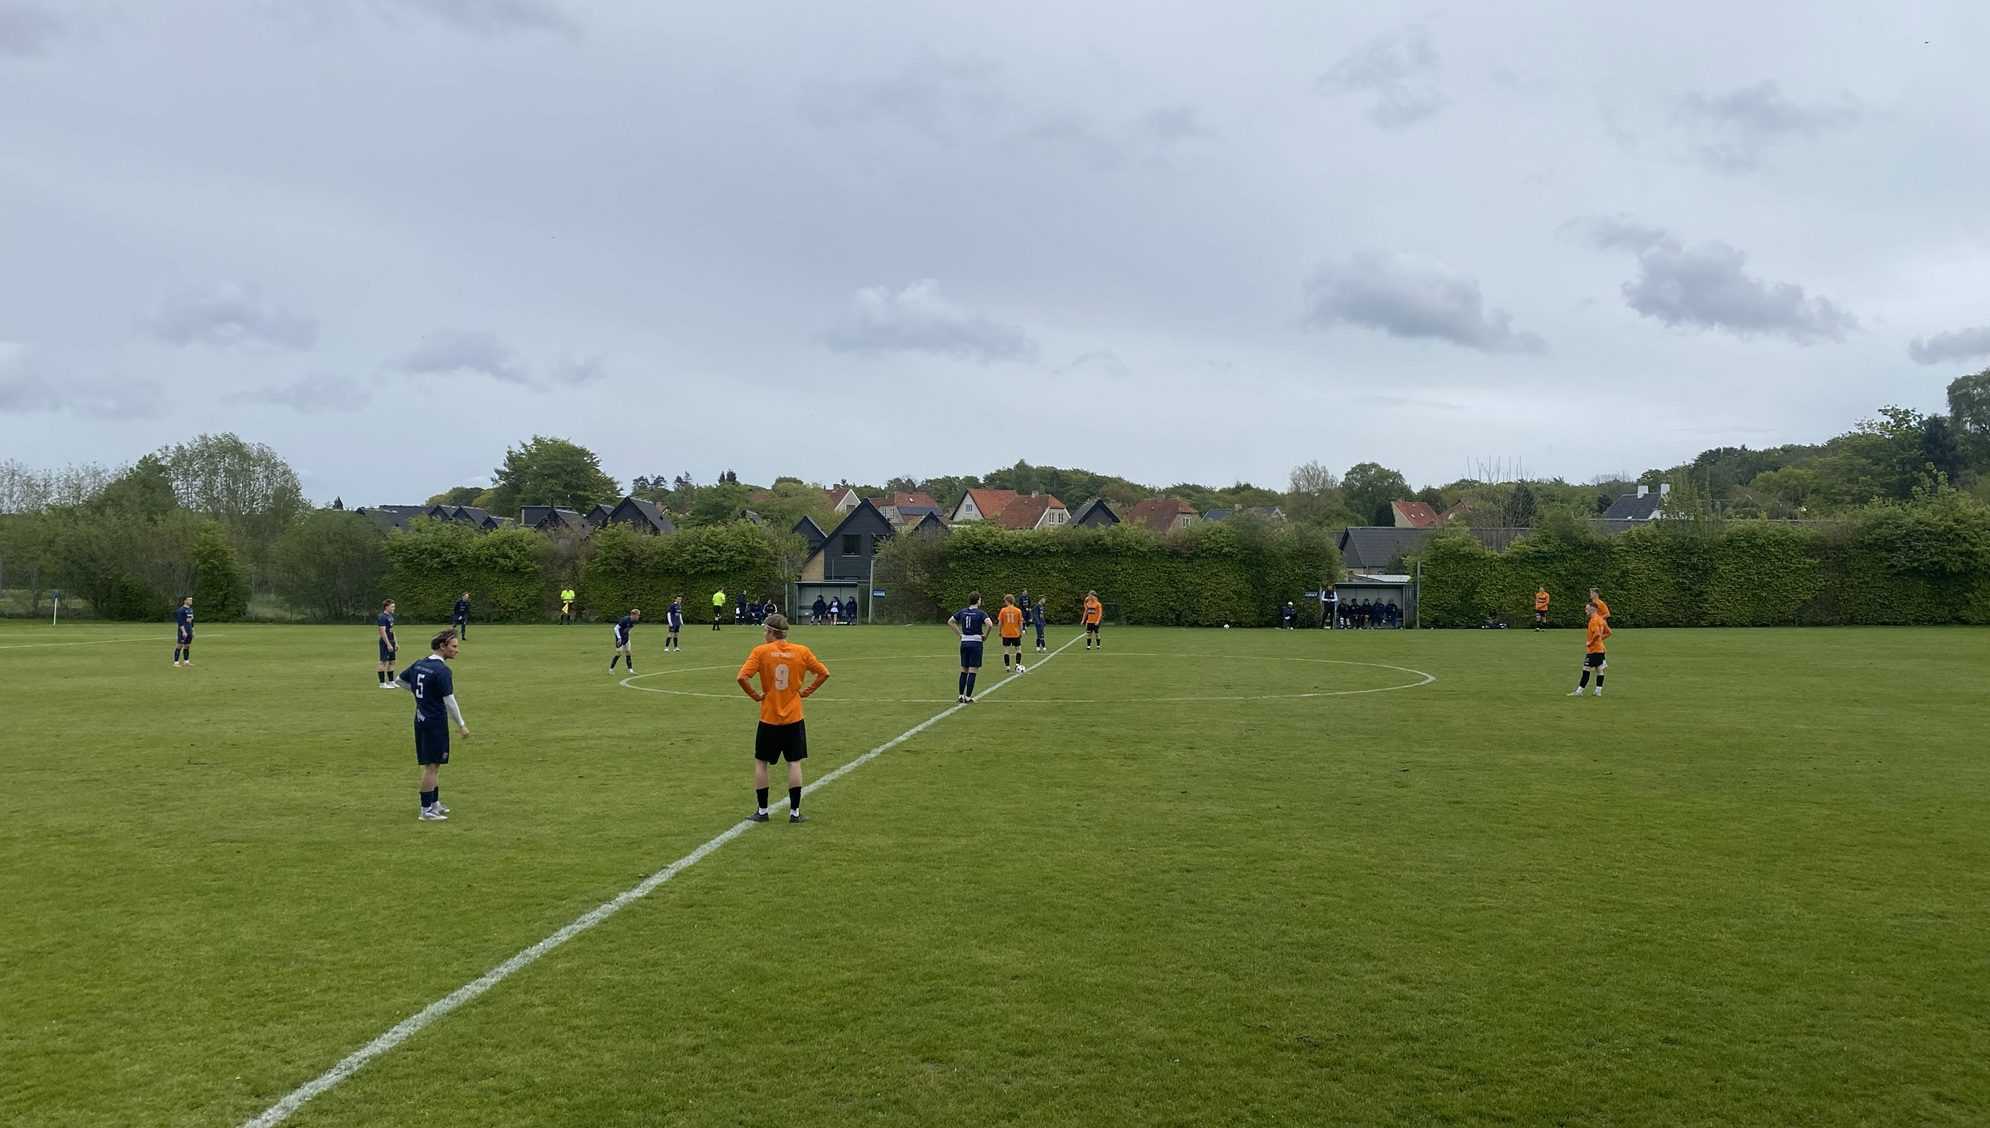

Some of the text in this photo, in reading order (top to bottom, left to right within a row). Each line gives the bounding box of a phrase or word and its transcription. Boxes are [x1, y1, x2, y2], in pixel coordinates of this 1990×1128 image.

[965, 615, 972, 629] 11
[415, 673, 426, 699] 5
[775, 663, 789, 691] 9
